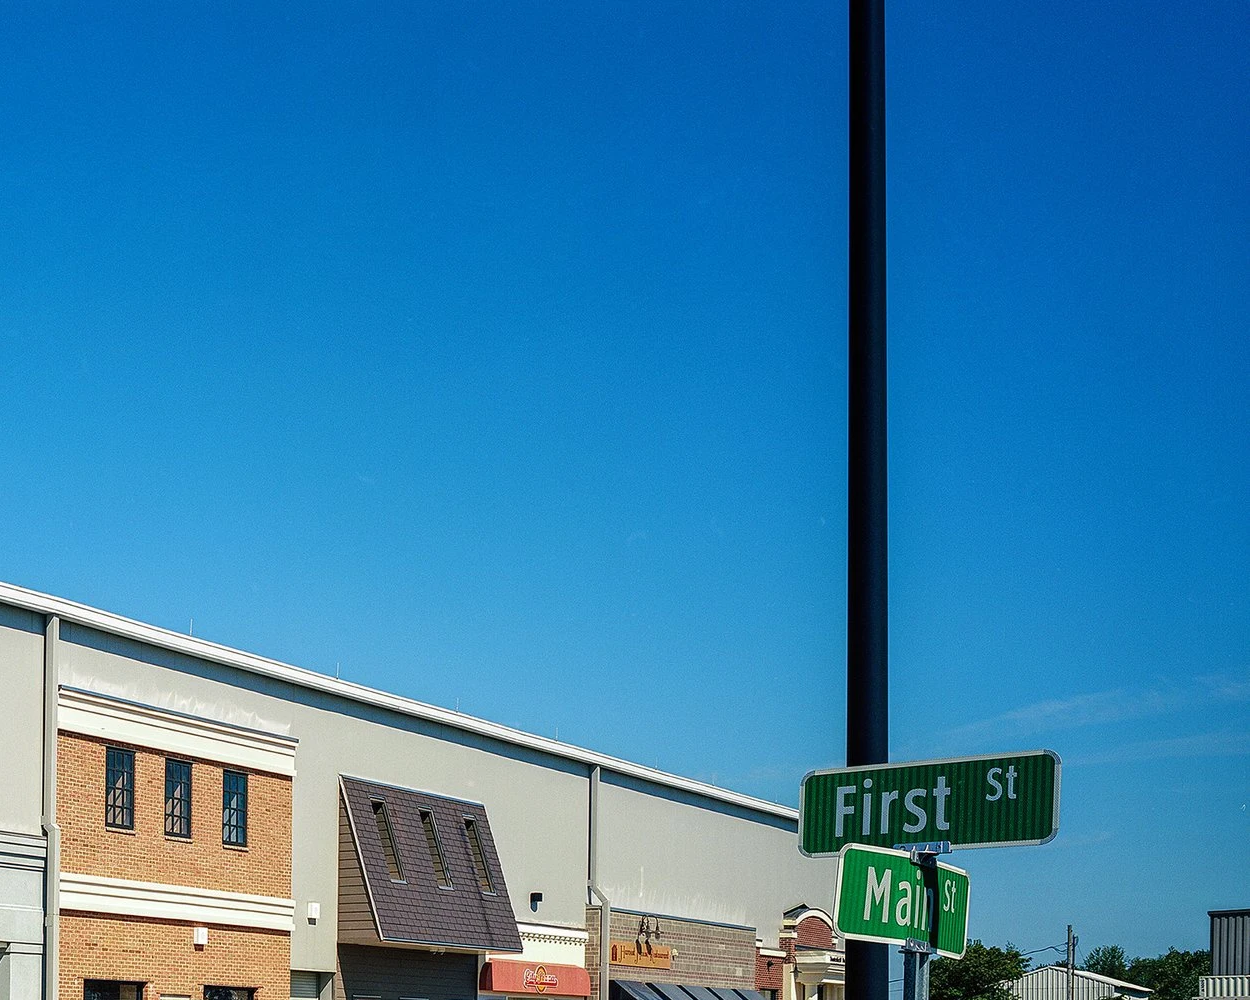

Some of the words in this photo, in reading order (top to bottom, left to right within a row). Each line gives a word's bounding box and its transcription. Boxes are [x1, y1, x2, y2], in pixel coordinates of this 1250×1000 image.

[834, 776, 951, 838] First
[985, 765, 1018, 802] St
[863, 866, 935, 932] Main
[943, 879, 957, 913] St
